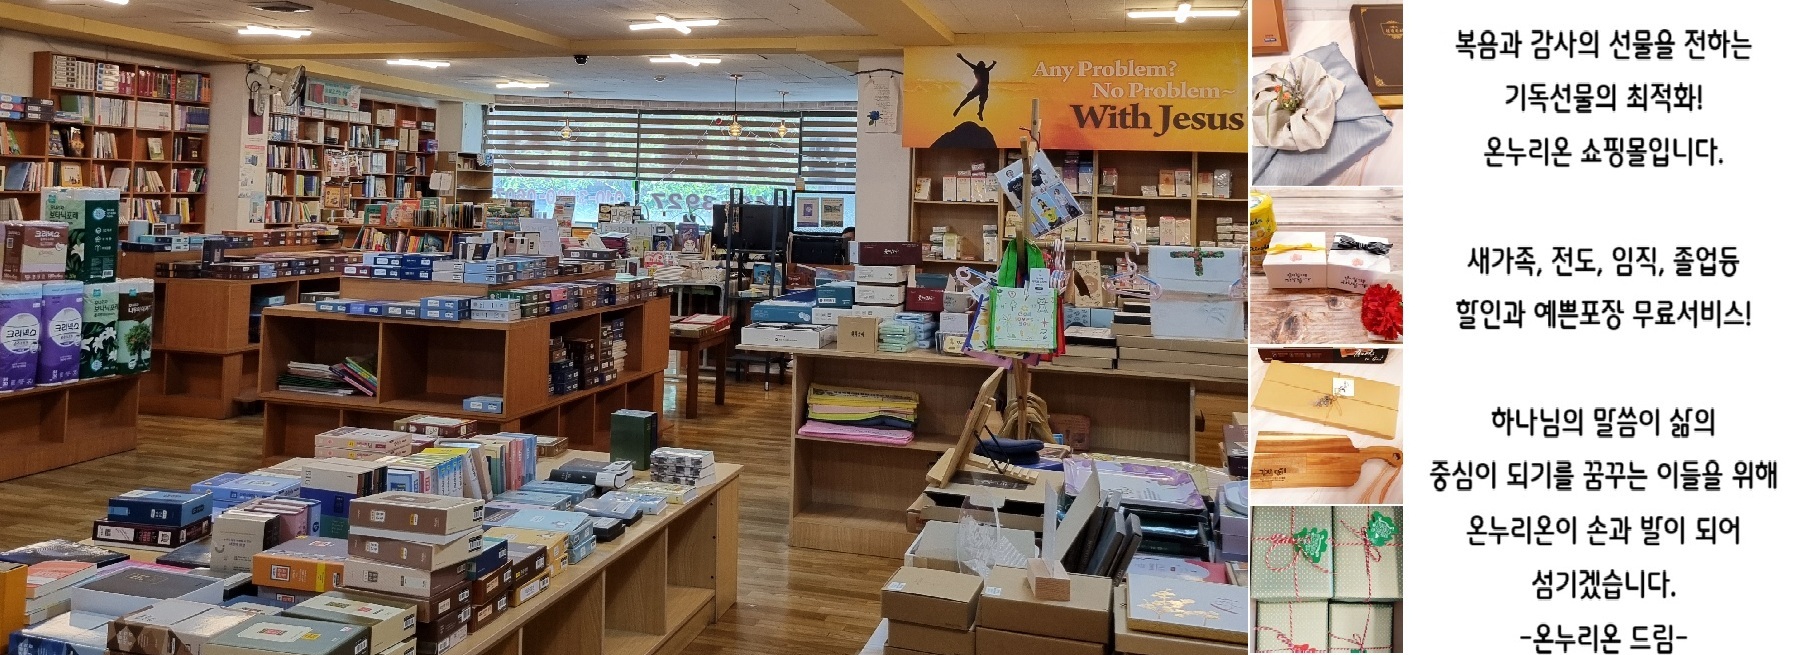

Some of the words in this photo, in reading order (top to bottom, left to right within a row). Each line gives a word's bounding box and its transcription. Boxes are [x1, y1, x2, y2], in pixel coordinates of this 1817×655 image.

[1032, 61, 1074, 82] Any
[1077, 59, 1178, 78] Problem?
[1092, 82, 1124, 98] No
[1070, 103, 1152, 130] With
[1153, 104, 1244, 137] Jesus
[6, 328, 37, 338] 크리넥스
[54, 322, 80, 333] 크리넥스
